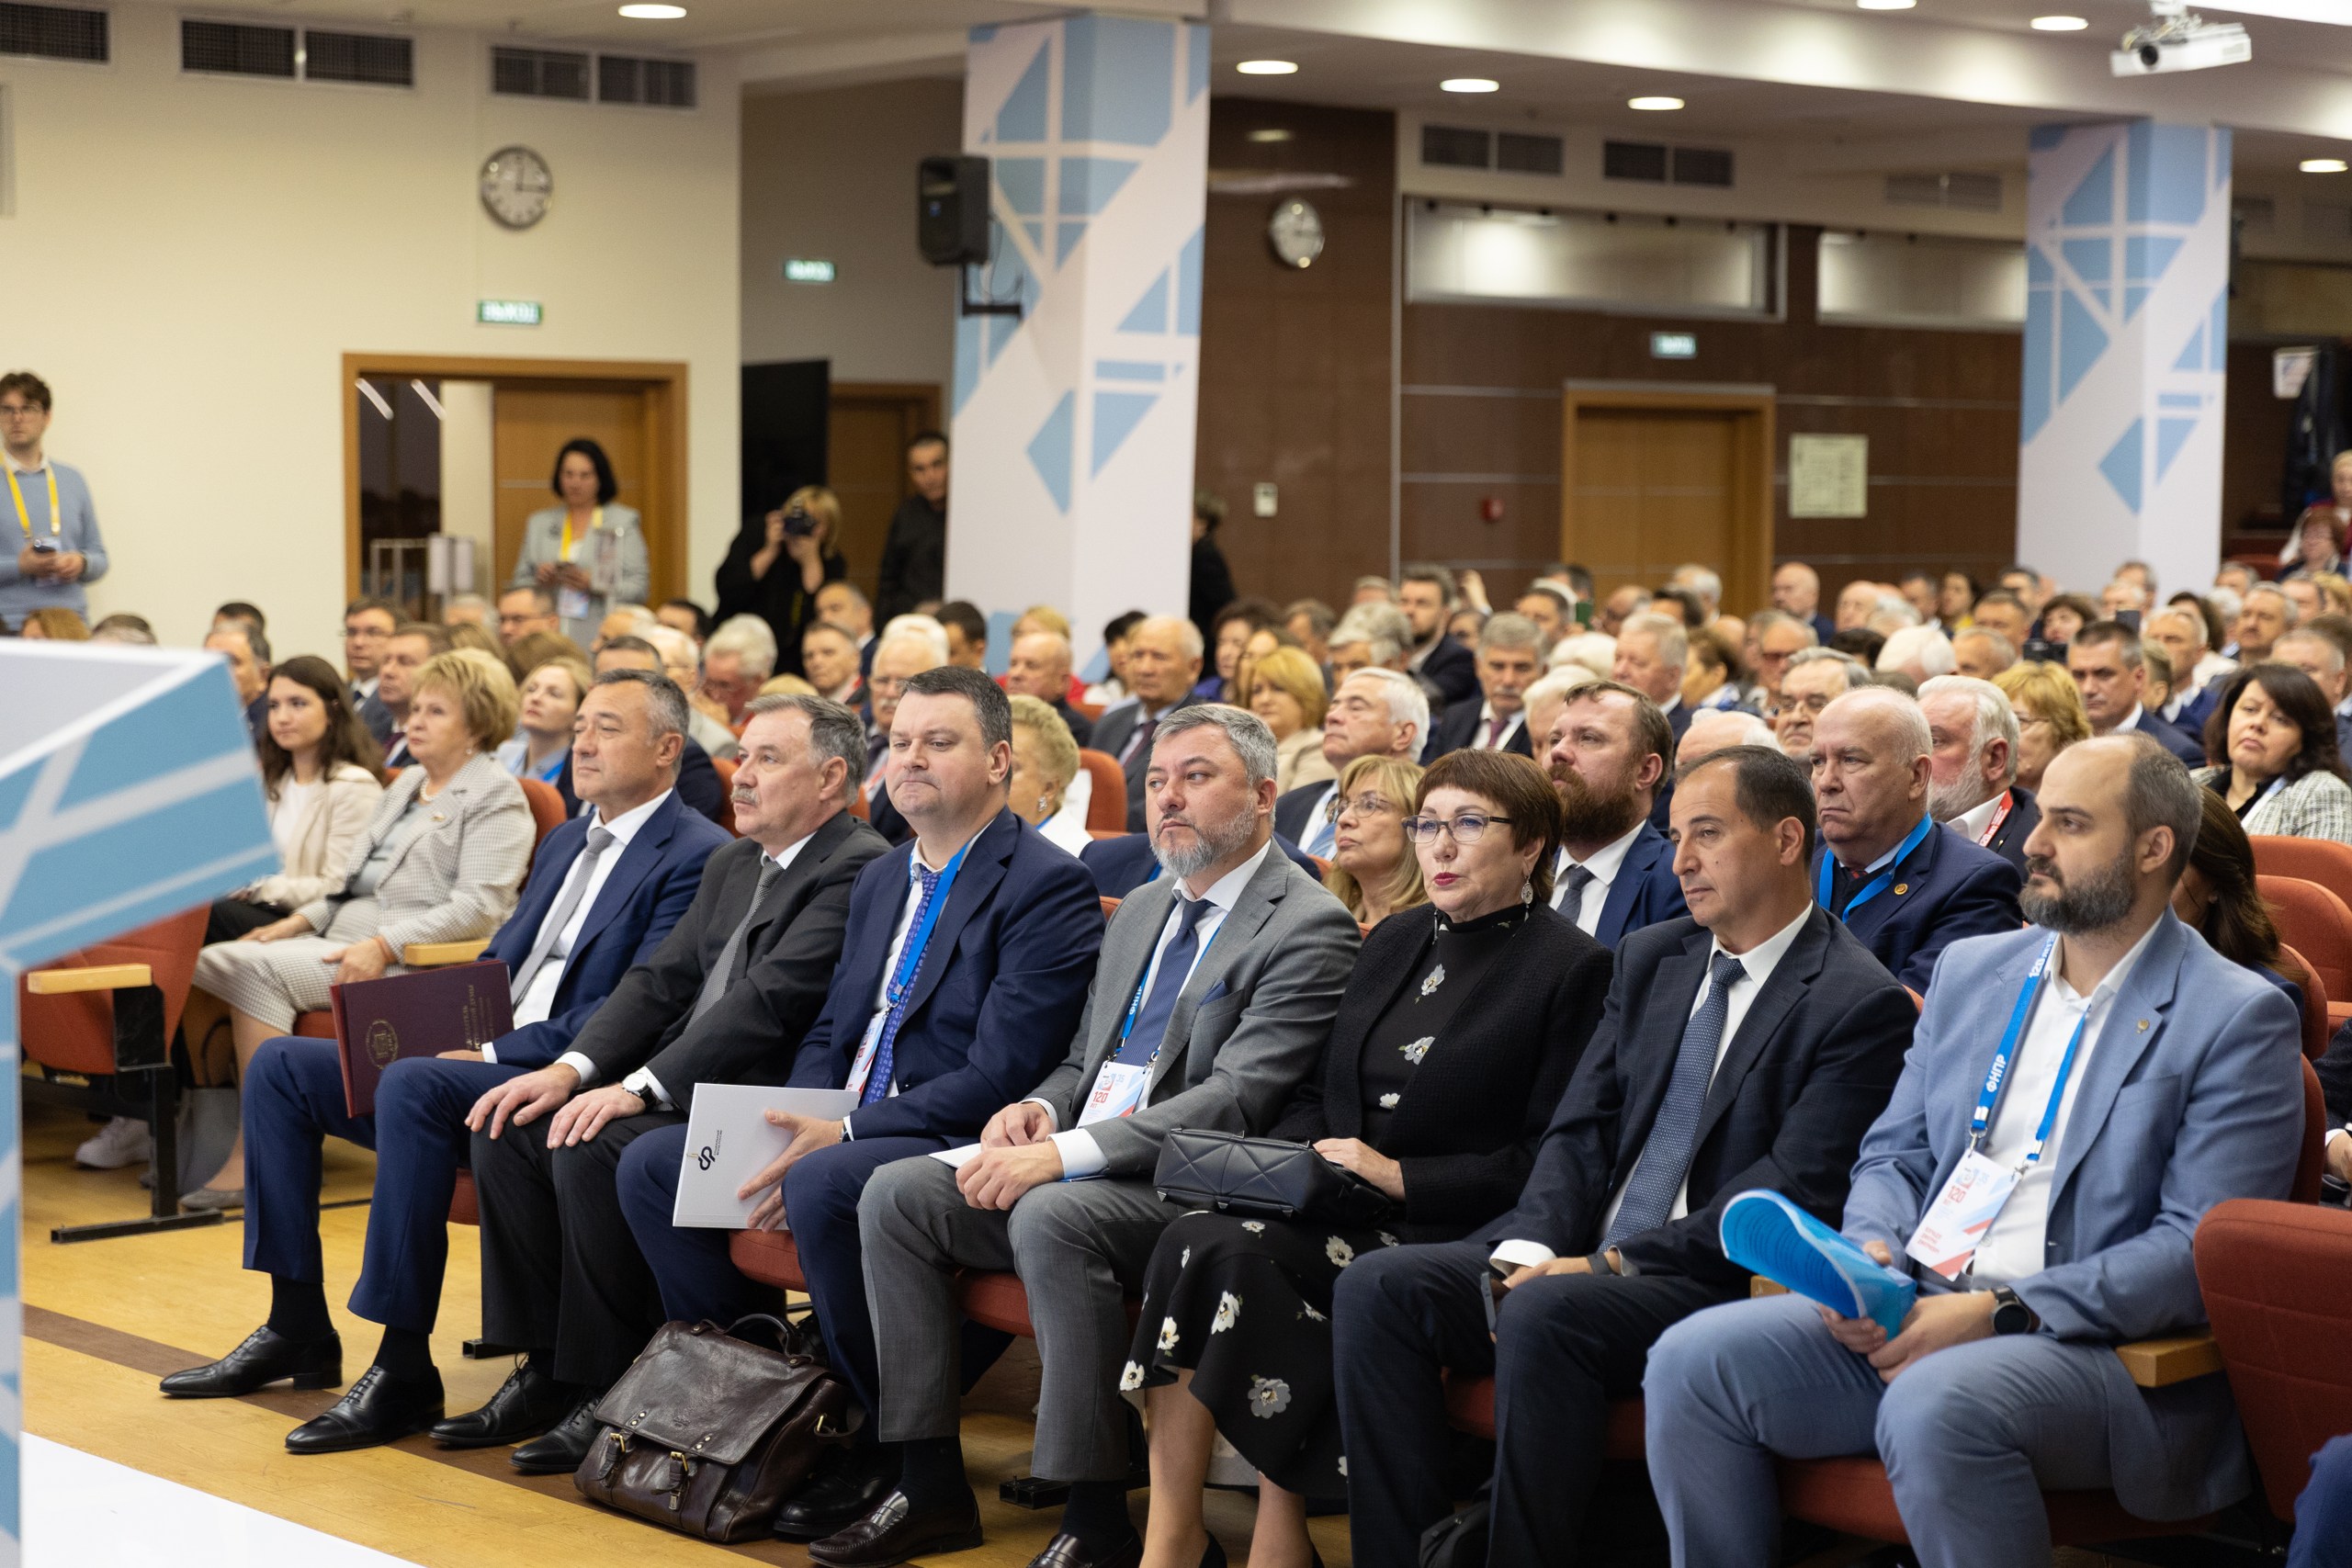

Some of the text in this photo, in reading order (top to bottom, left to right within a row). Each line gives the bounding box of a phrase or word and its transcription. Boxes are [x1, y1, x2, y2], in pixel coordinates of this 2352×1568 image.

[2029, 958, 2046, 977] 120
[1129, 986, 1142, 1015] ФНПР
[1986, 1054, 2006, 1092] ФНПР
[1093, 1091, 1109, 1103] 120
[1948, 1185, 1967, 1203] 120
